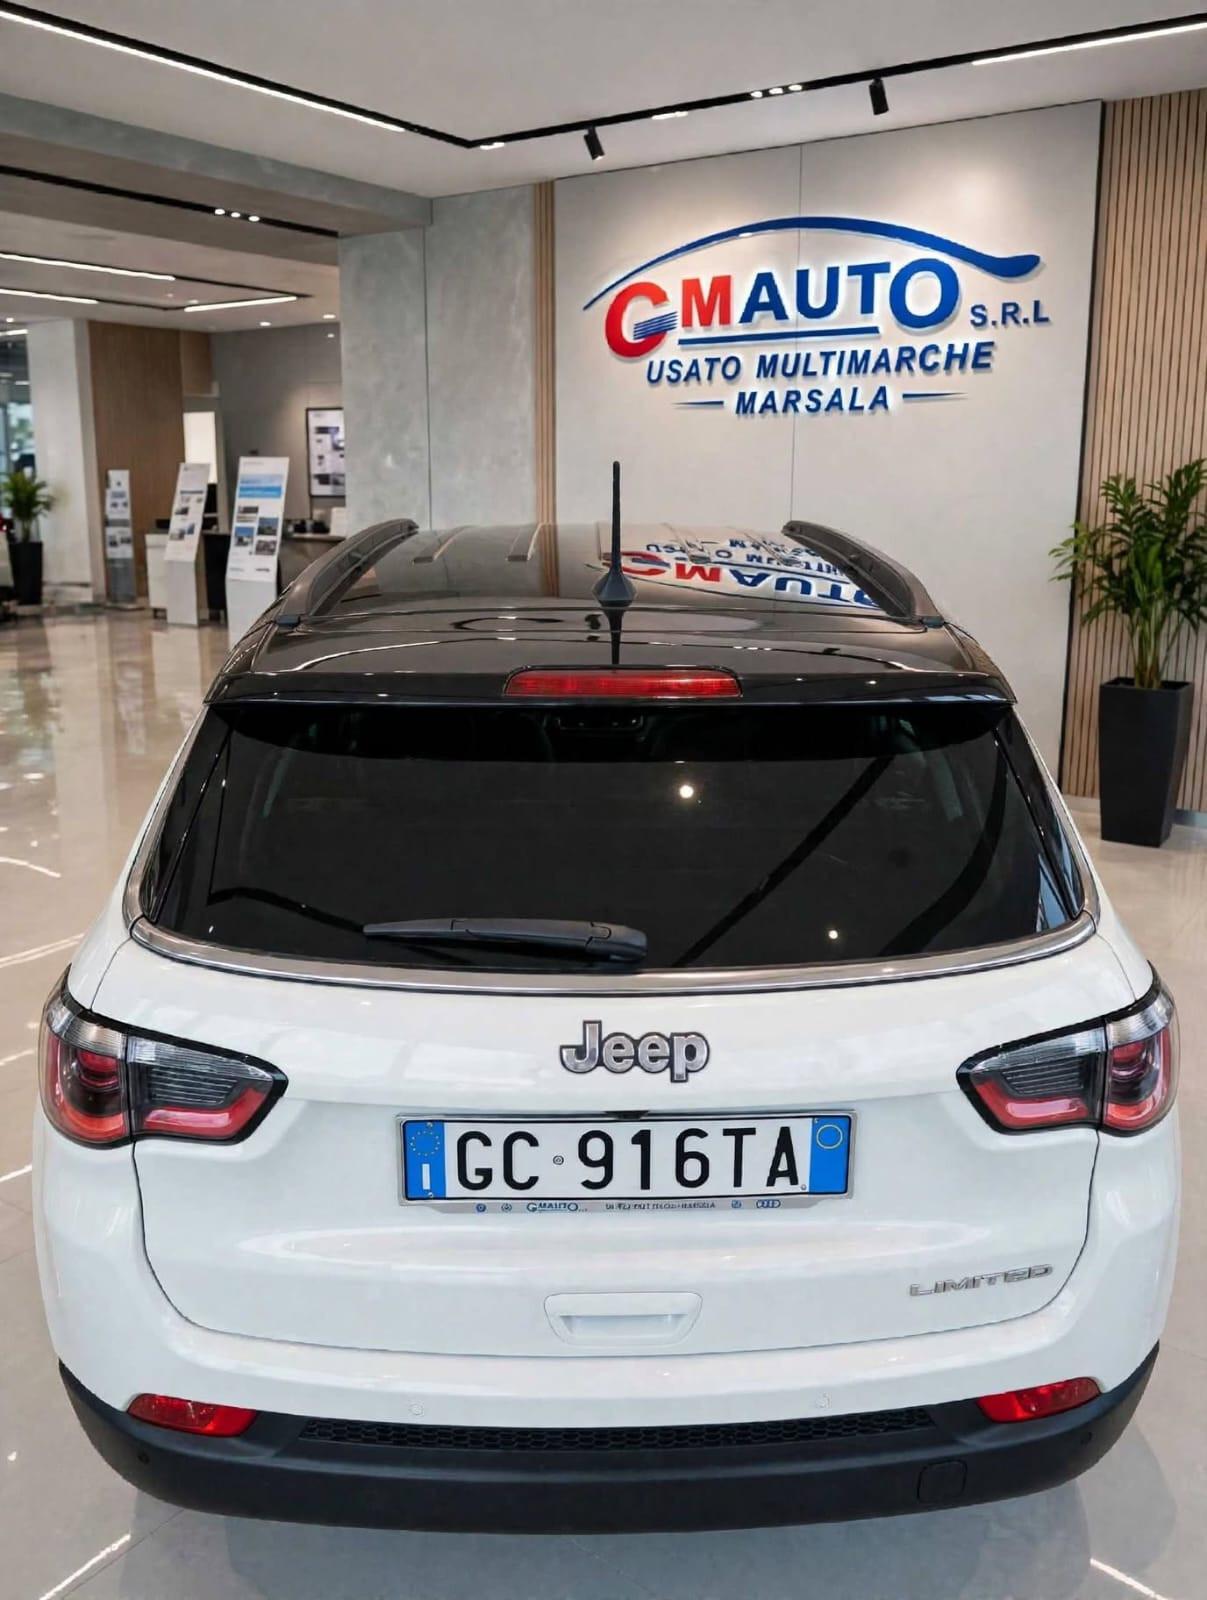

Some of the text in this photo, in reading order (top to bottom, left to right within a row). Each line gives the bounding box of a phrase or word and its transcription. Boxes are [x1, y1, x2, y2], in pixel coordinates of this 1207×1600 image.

[969, 299, 1050, 327] S.R.L
[646, 341, 995, 384] USATO MULTIMARCHE
[735, 386, 890, 414] MARSALA
[560, 1019, 711, 1083] Jeep
[909, 1263, 1054, 1297] LIMITED
